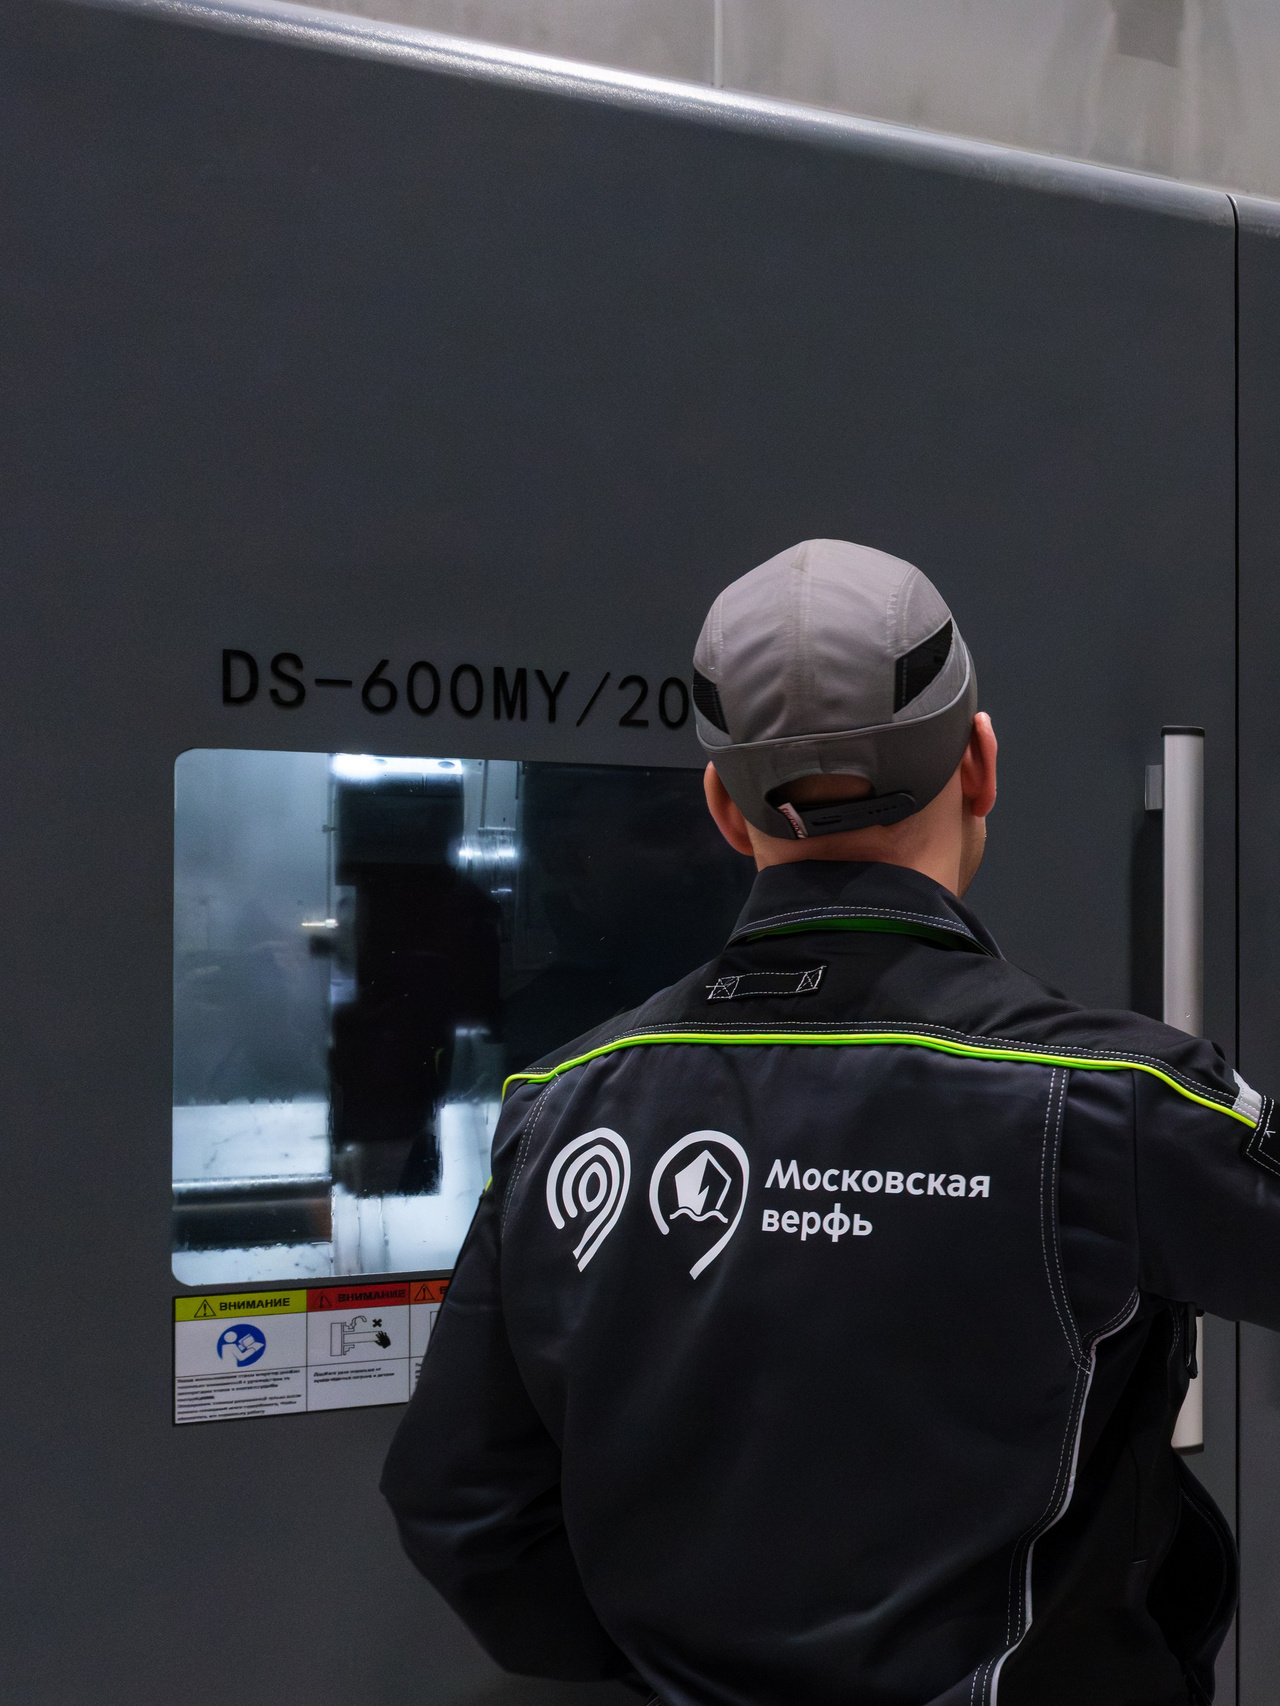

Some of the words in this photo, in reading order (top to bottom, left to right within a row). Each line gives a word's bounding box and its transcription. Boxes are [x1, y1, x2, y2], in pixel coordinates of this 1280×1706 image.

[222, 649, 690, 731] DS-600MY/20
[765, 1158, 991, 1198] Московская
[761, 1203, 873, 1243] верфь
[219, 1297, 290, 1311] ВНИМАНИЕ
[338, 1289, 406, 1302] ВНИМАНИЕ
